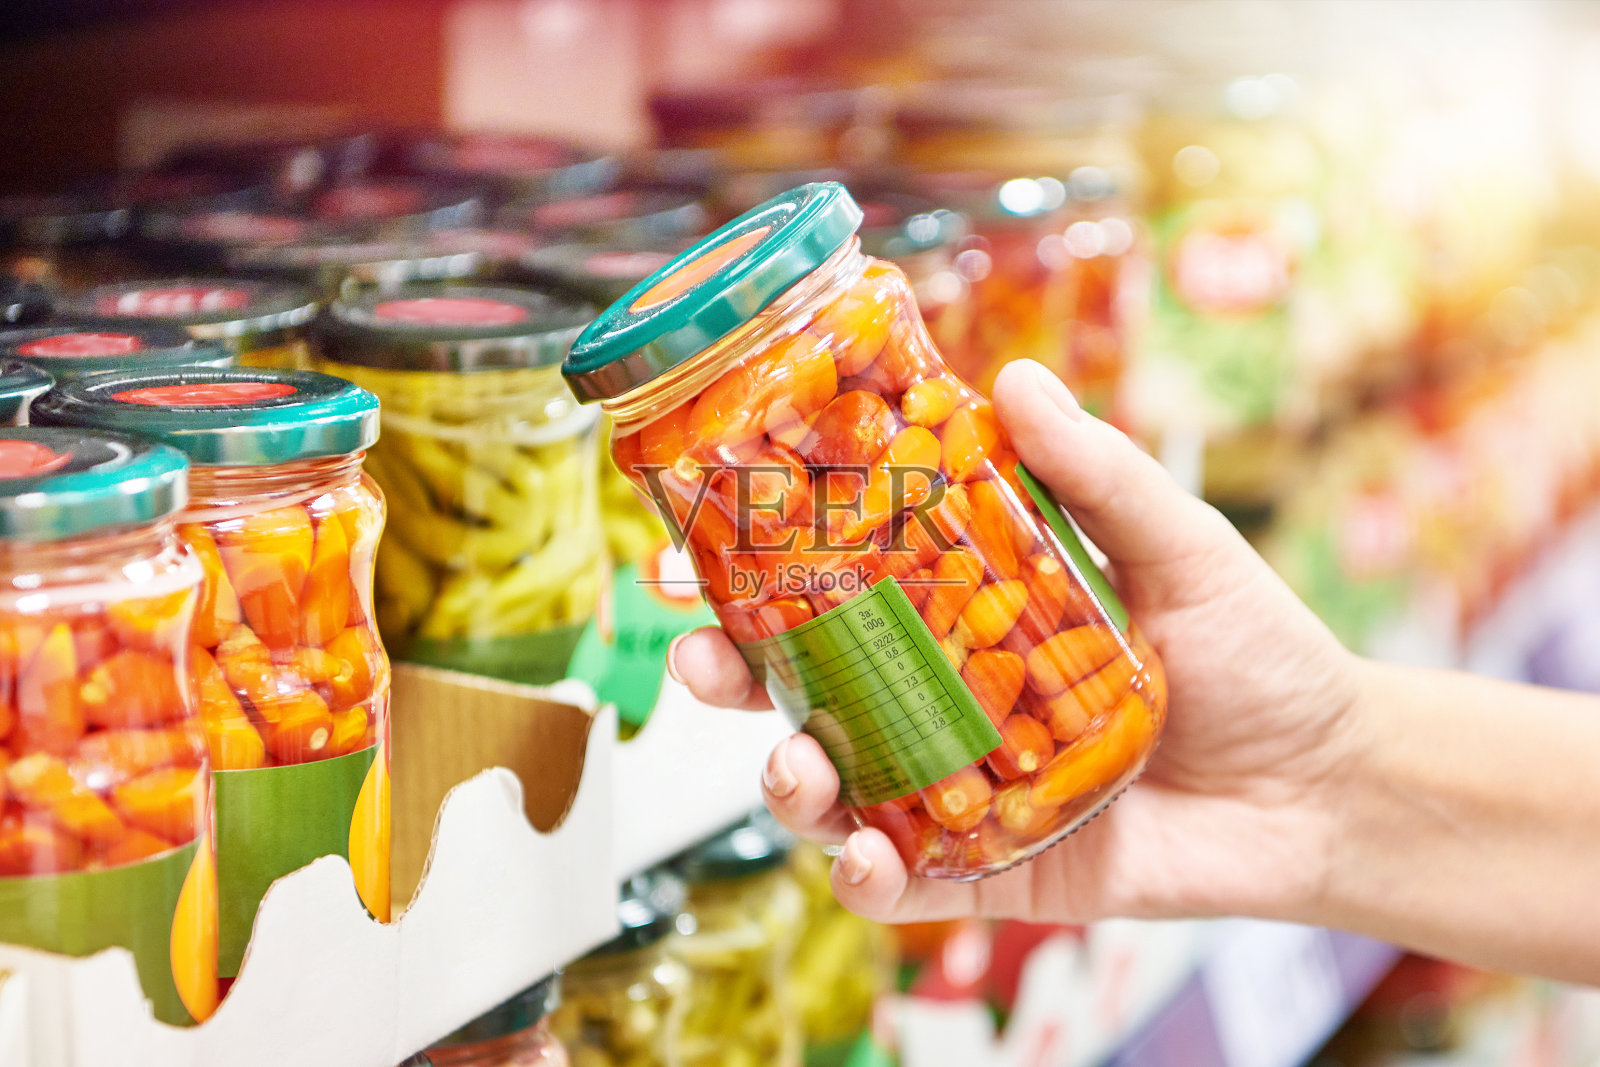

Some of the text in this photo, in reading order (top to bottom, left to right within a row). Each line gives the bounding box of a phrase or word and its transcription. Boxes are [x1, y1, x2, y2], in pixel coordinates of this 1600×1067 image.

[862, 617, 885, 632] 100g
[873, 632, 896, 650] 92/22
[885, 646, 899, 659] 0,6
[897, 662, 905, 671] 0
[904, 675, 919, 689] 7,3
[917, 692, 925, 701] 0
[925, 705, 939, 717] 1,2
[932, 717, 946, 729] 2,8
